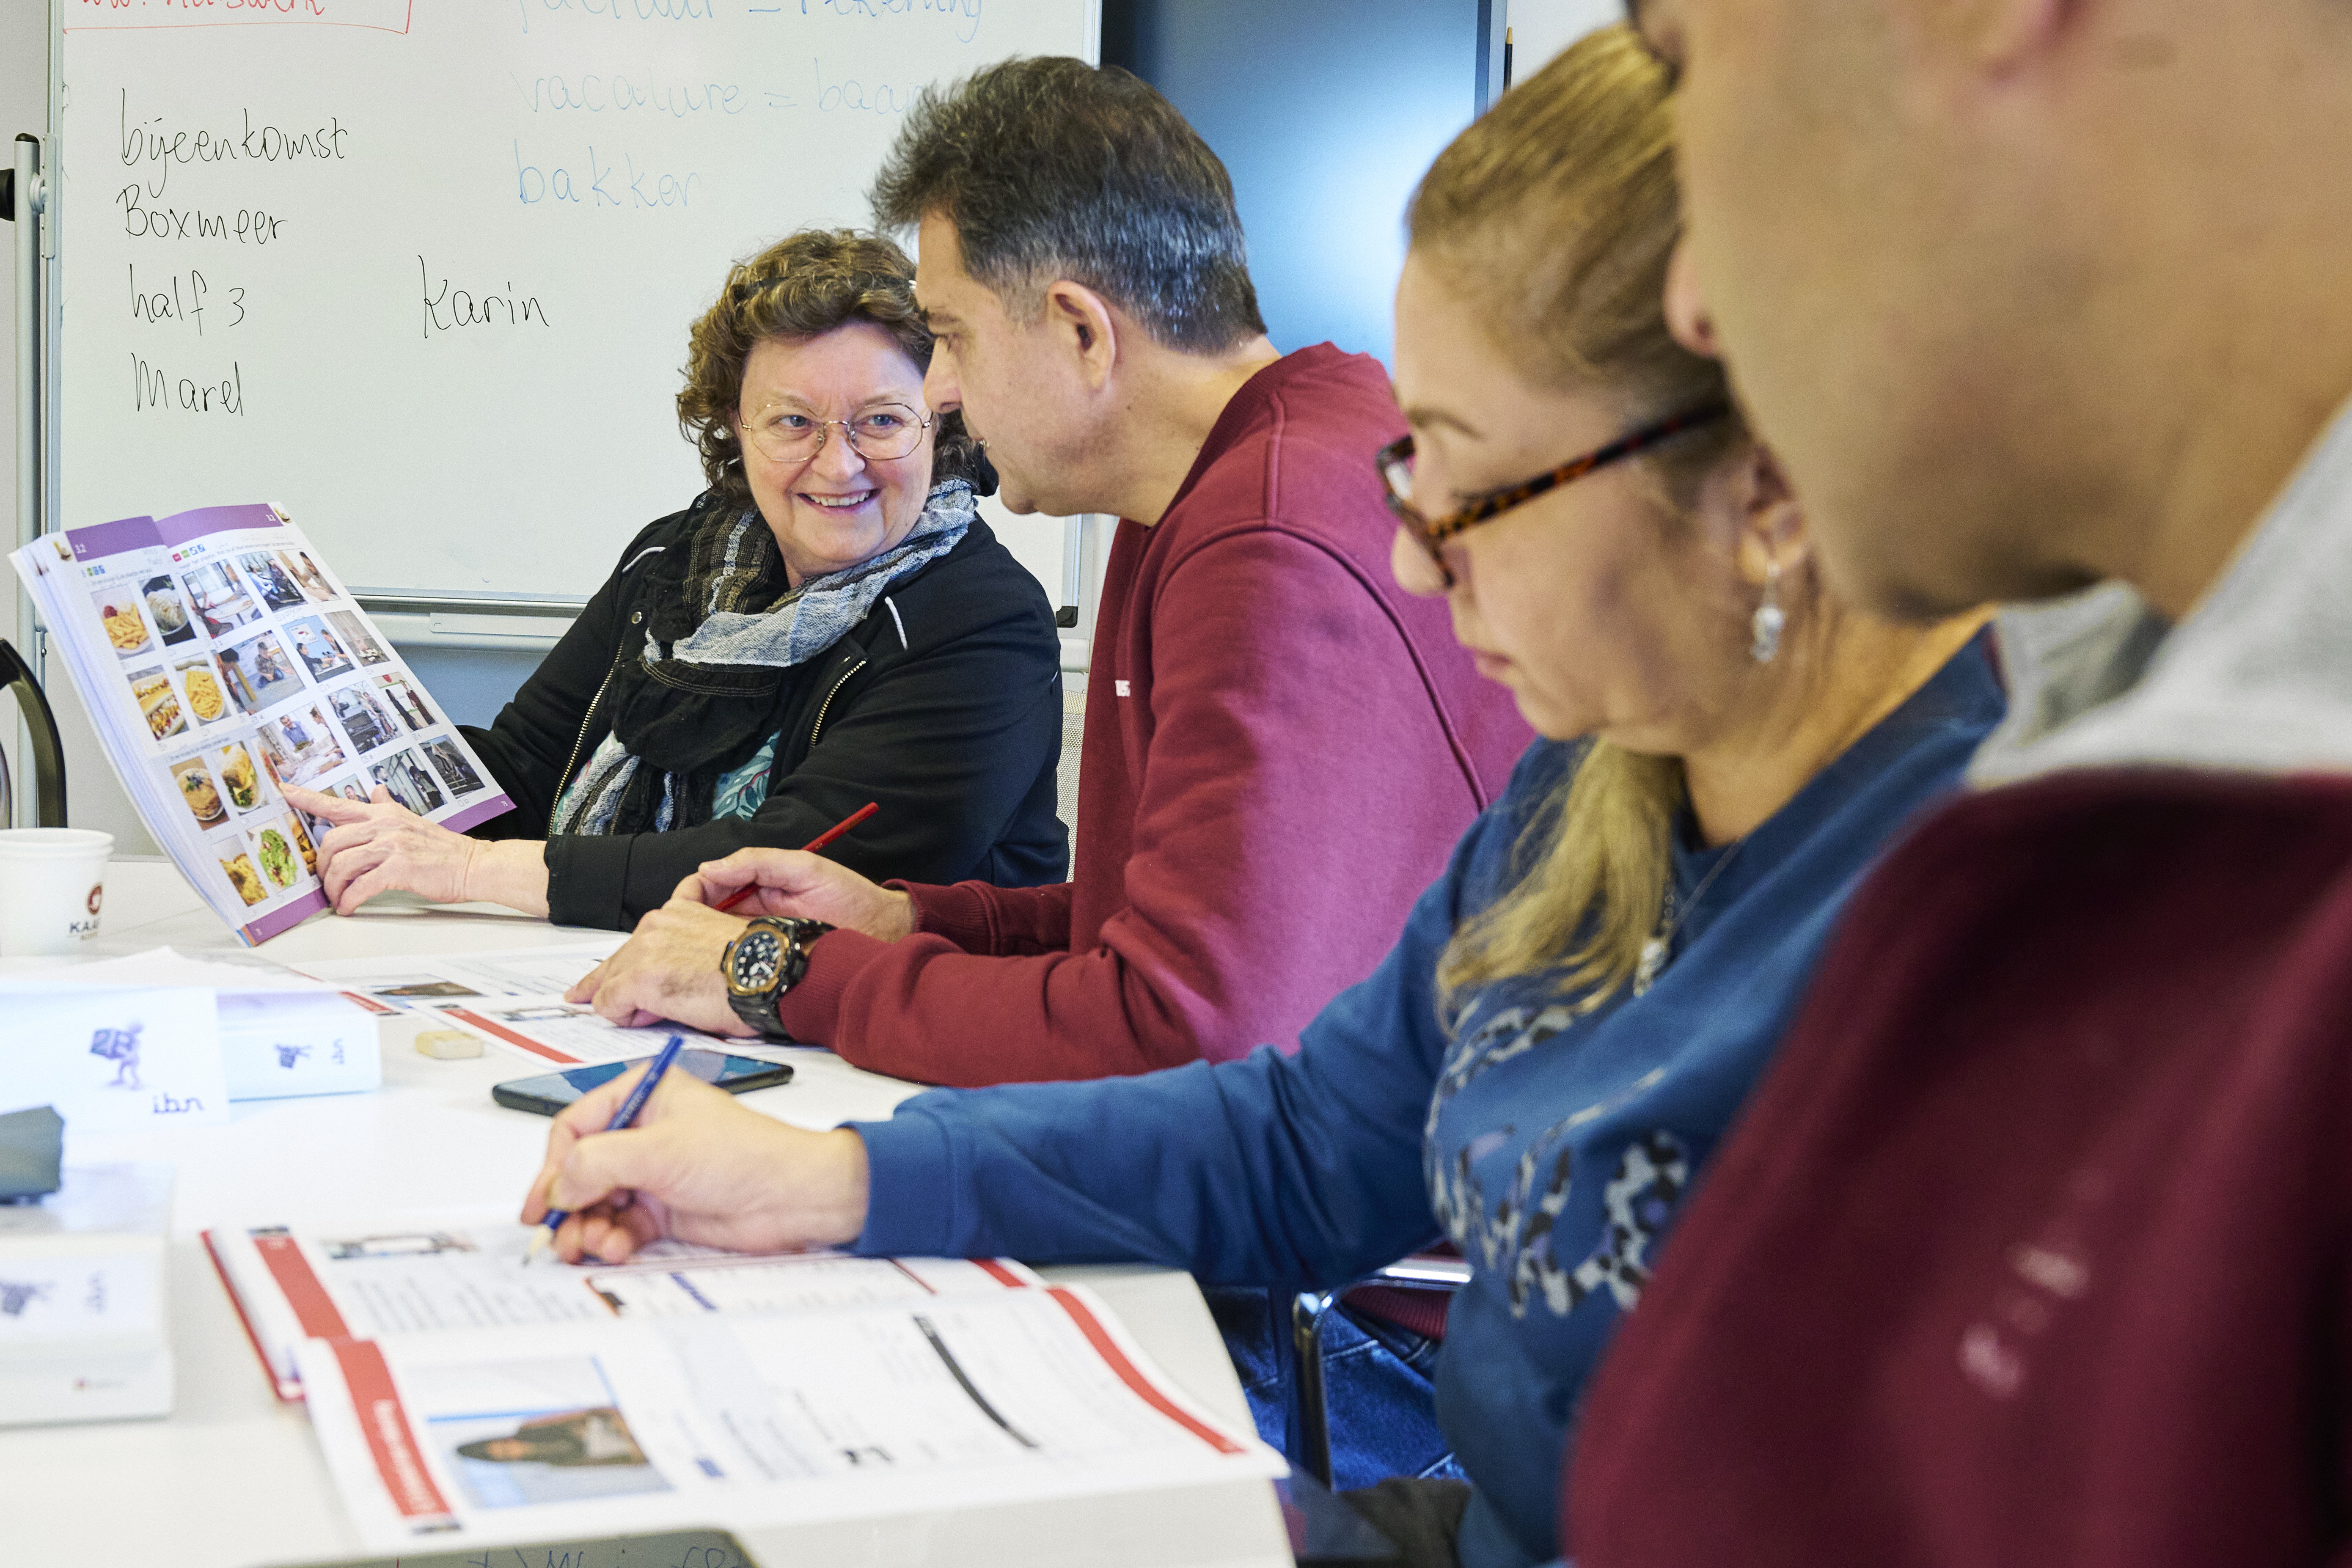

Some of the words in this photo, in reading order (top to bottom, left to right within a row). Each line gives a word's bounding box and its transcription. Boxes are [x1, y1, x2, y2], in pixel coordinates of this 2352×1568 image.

[510, 69, 748, 118] vacature
[119, 88, 348, 198] bijeenkomst
[514, 139, 701, 208] bakker
[116, 184, 288, 245] Boxmeer
[129, 263, 207, 336] half
[229, 288, 245, 327] 3
[418, 255, 550, 339] Karin
[131, 352, 244, 417] Marel
